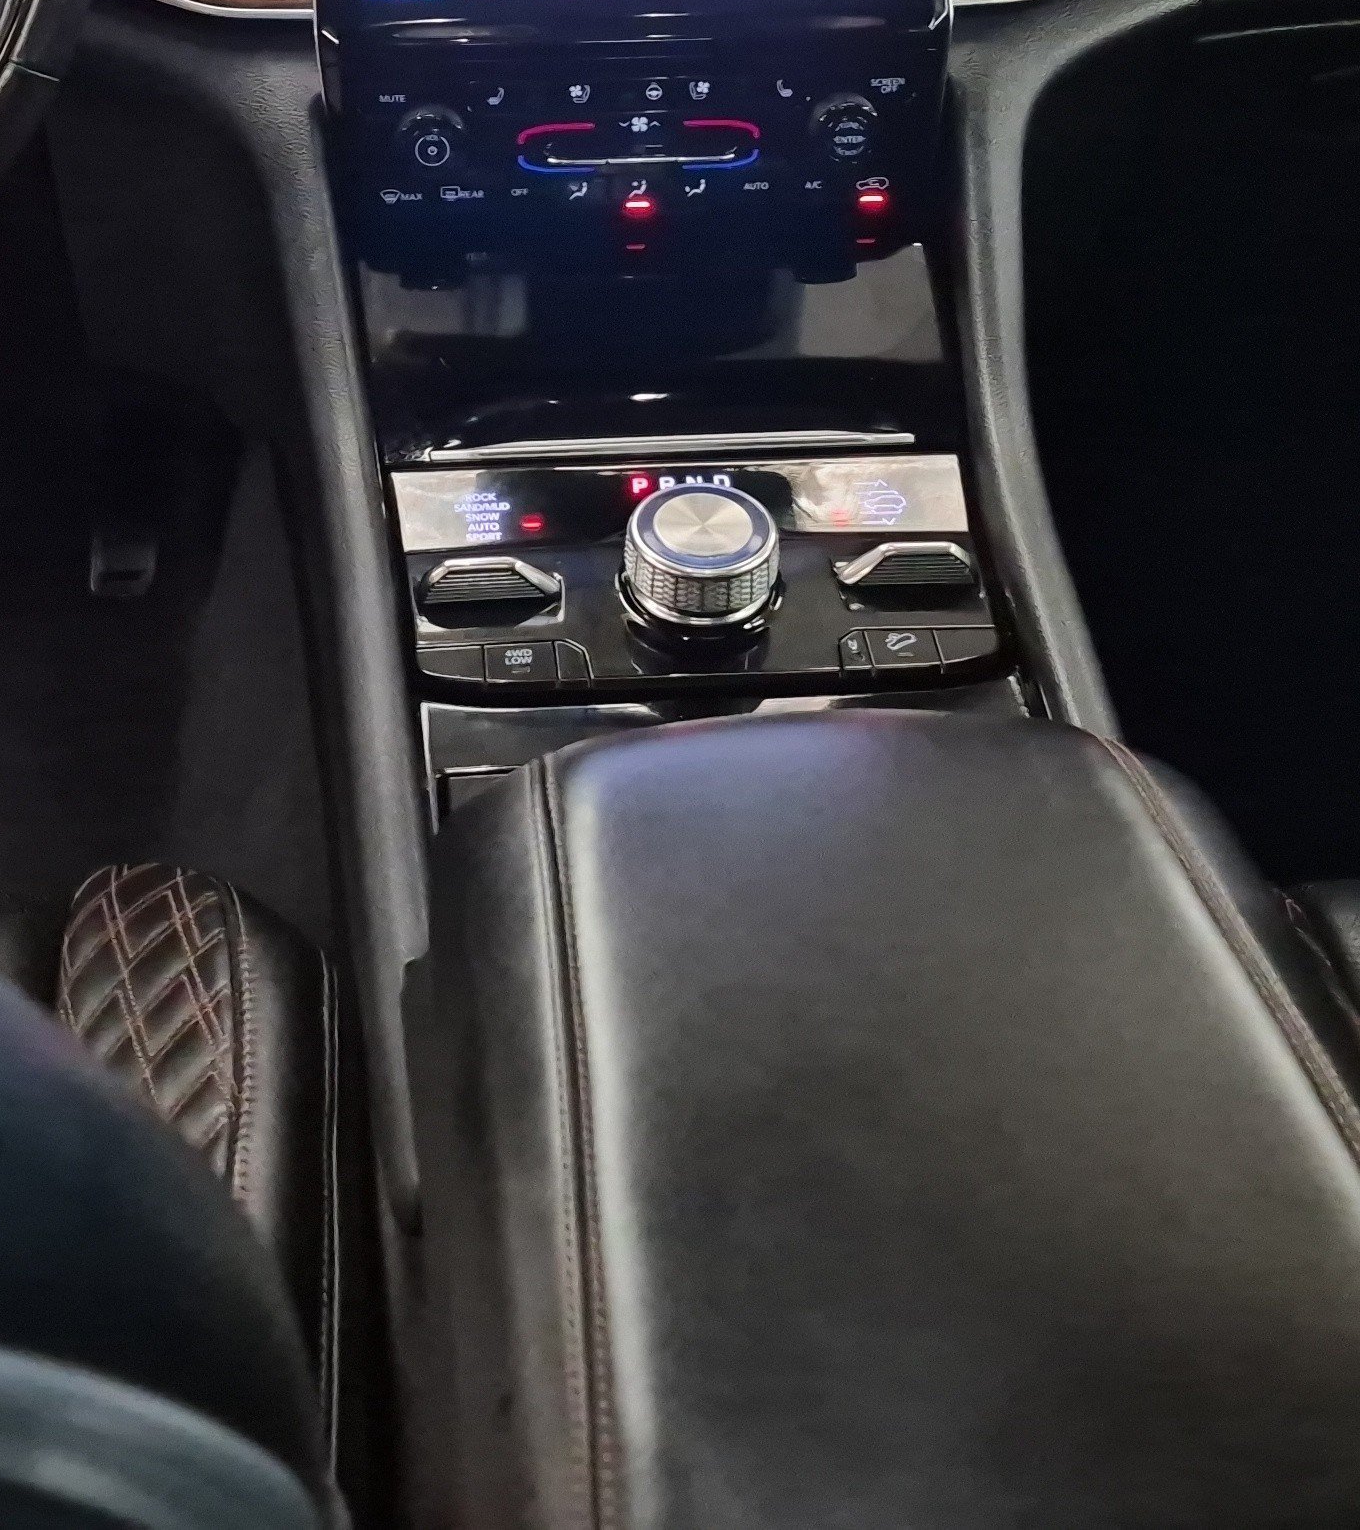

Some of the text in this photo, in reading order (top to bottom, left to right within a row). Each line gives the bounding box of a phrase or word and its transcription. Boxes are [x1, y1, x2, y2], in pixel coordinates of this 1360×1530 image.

[378, 94, 407, 103] MUTE
[743, 181, 769, 190] AUTO
[400, 192, 423, 201] MAX
[510, 188, 529, 197] OFF
[632, 477, 649, 494] P
[465, 492, 497, 502] ROCK
[453, 501, 511, 513] SAND/MUD
[465, 512, 500, 522] SNOW
[467, 522, 500, 532] AUTO
[465, 532, 503, 542] SPORT
[504, 648, 533, 657] 4WD
[504, 656, 533, 666] LOW
